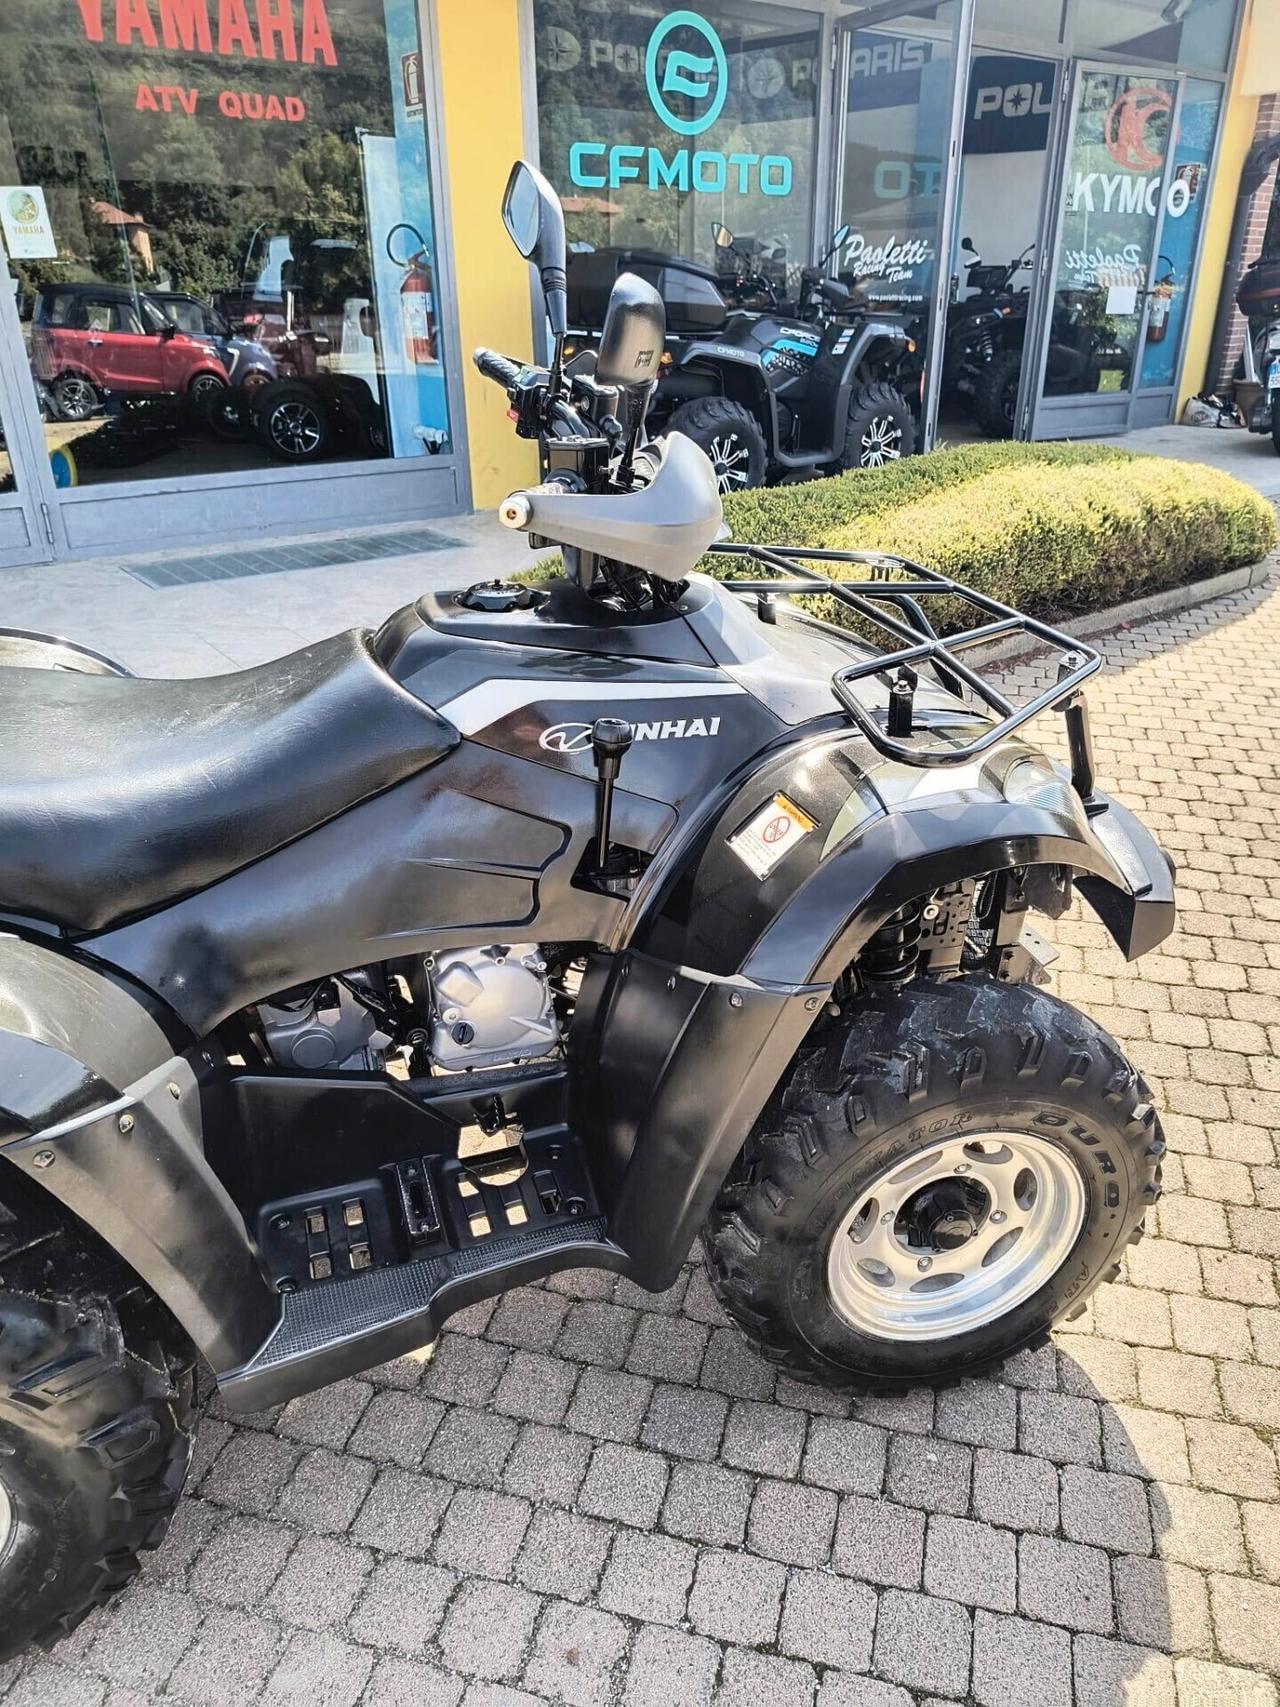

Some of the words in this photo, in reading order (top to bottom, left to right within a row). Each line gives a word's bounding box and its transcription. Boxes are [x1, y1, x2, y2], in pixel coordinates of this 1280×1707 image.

[77, 0, 338, 66] YAMAHA
[135, 84, 197, 115] ATV
[219, 92, 305, 122] QUAD
[569, 141, 793, 197] CFMOTO
[1072, 172, 1190, 218] KYMCO
[844, 234, 928, 266] Paoletti
[853, 260, 886, 277] Racing
[886, 266, 913, 283] Team
[629, 716, 721, 742] NHAI
[1033, 1111, 1120, 1208] DURO
